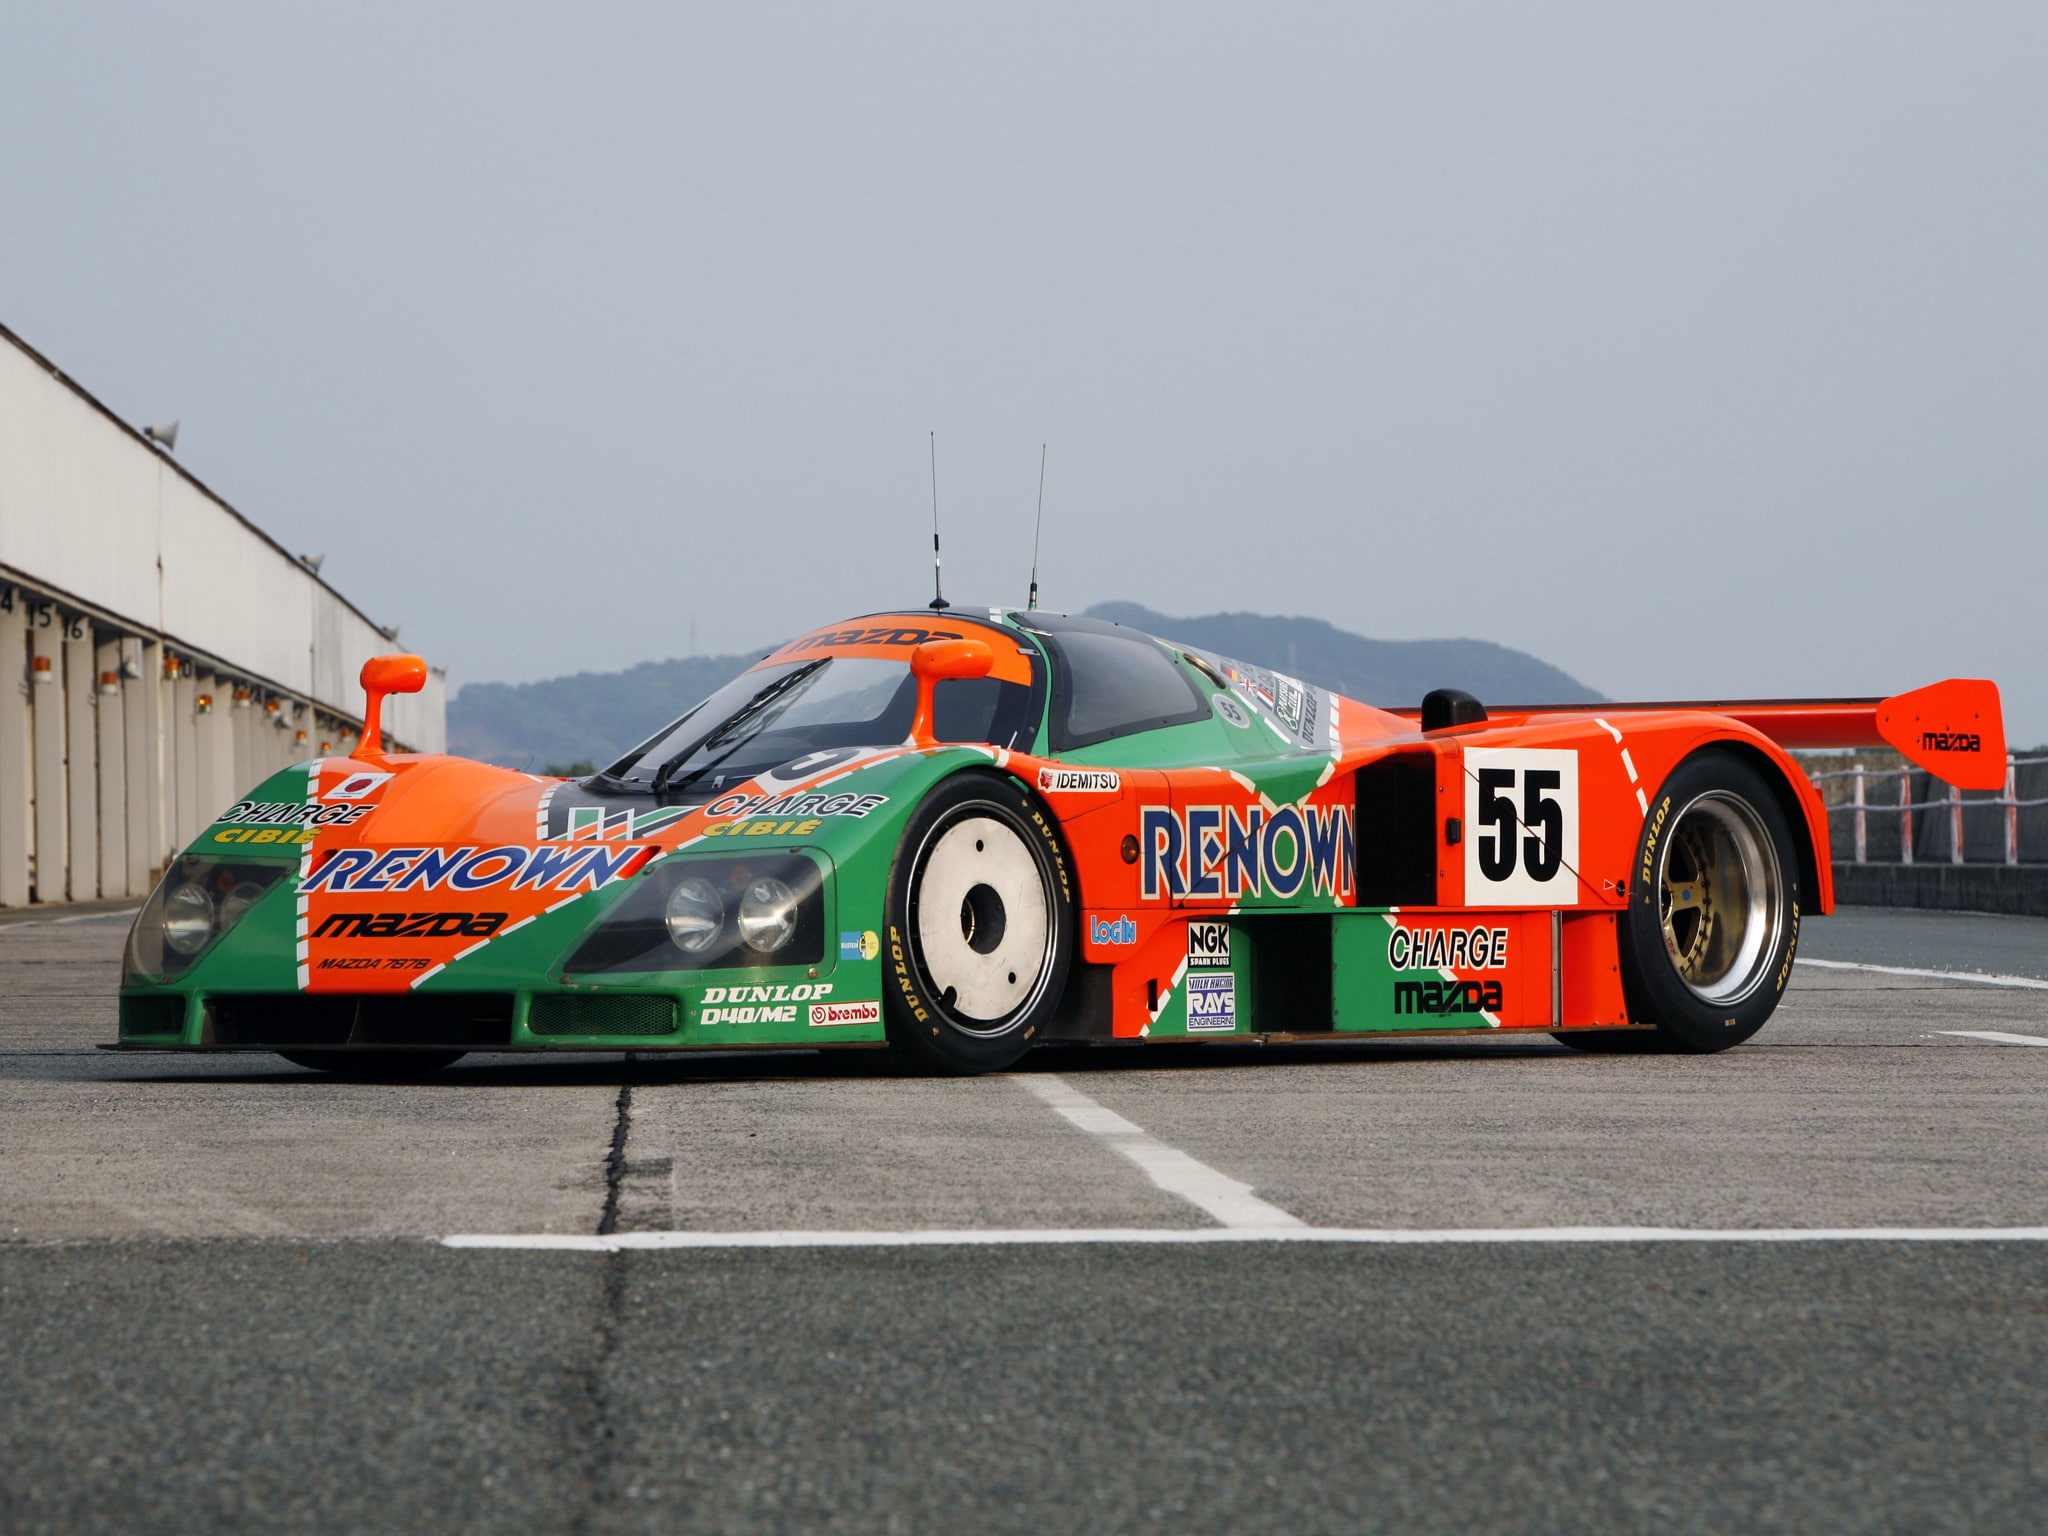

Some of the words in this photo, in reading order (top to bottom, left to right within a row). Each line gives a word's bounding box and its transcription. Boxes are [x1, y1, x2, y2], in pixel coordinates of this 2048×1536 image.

[62, 615, 84, 640] 16
[1221, 701, 1242, 720] 55
[1302, 691, 1317, 744] DUNLOP
[1057, 773, 1118, 789] IDEMITSU
[215, 801, 380, 826] CHARGE
[704, 792, 890, 818] CHARGE
[1478, 768, 1563, 882] 55
[1140, 804, 1357, 900] RENOWN
[1642, 796, 1672, 885] DUNLOP
[294, 846, 641, 893] RENOWN
[1032, 811, 1071, 903] DUNLOP
[1190, 925, 1229, 954] NGK
[1388, 926, 1509, 970] CHARGE
[1775, 901, 1800, 992] DUNLOP
[316, 958, 382, 969] MAZDA
[889, 925, 930, 1023] DUNLOP
[1190, 957, 1211, 966] SPARK
[1212, 957, 1230, 966] PLUGS
[700, 983, 833, 1004] DUNLOP
[1189, 992, 1234, 1015] RAYS
[700, 1005, 797, 1025] D40/M2
[828, 1005, 877, 1021] brembo
[1189, 1017, 1234, 1026] ENGINEERING
